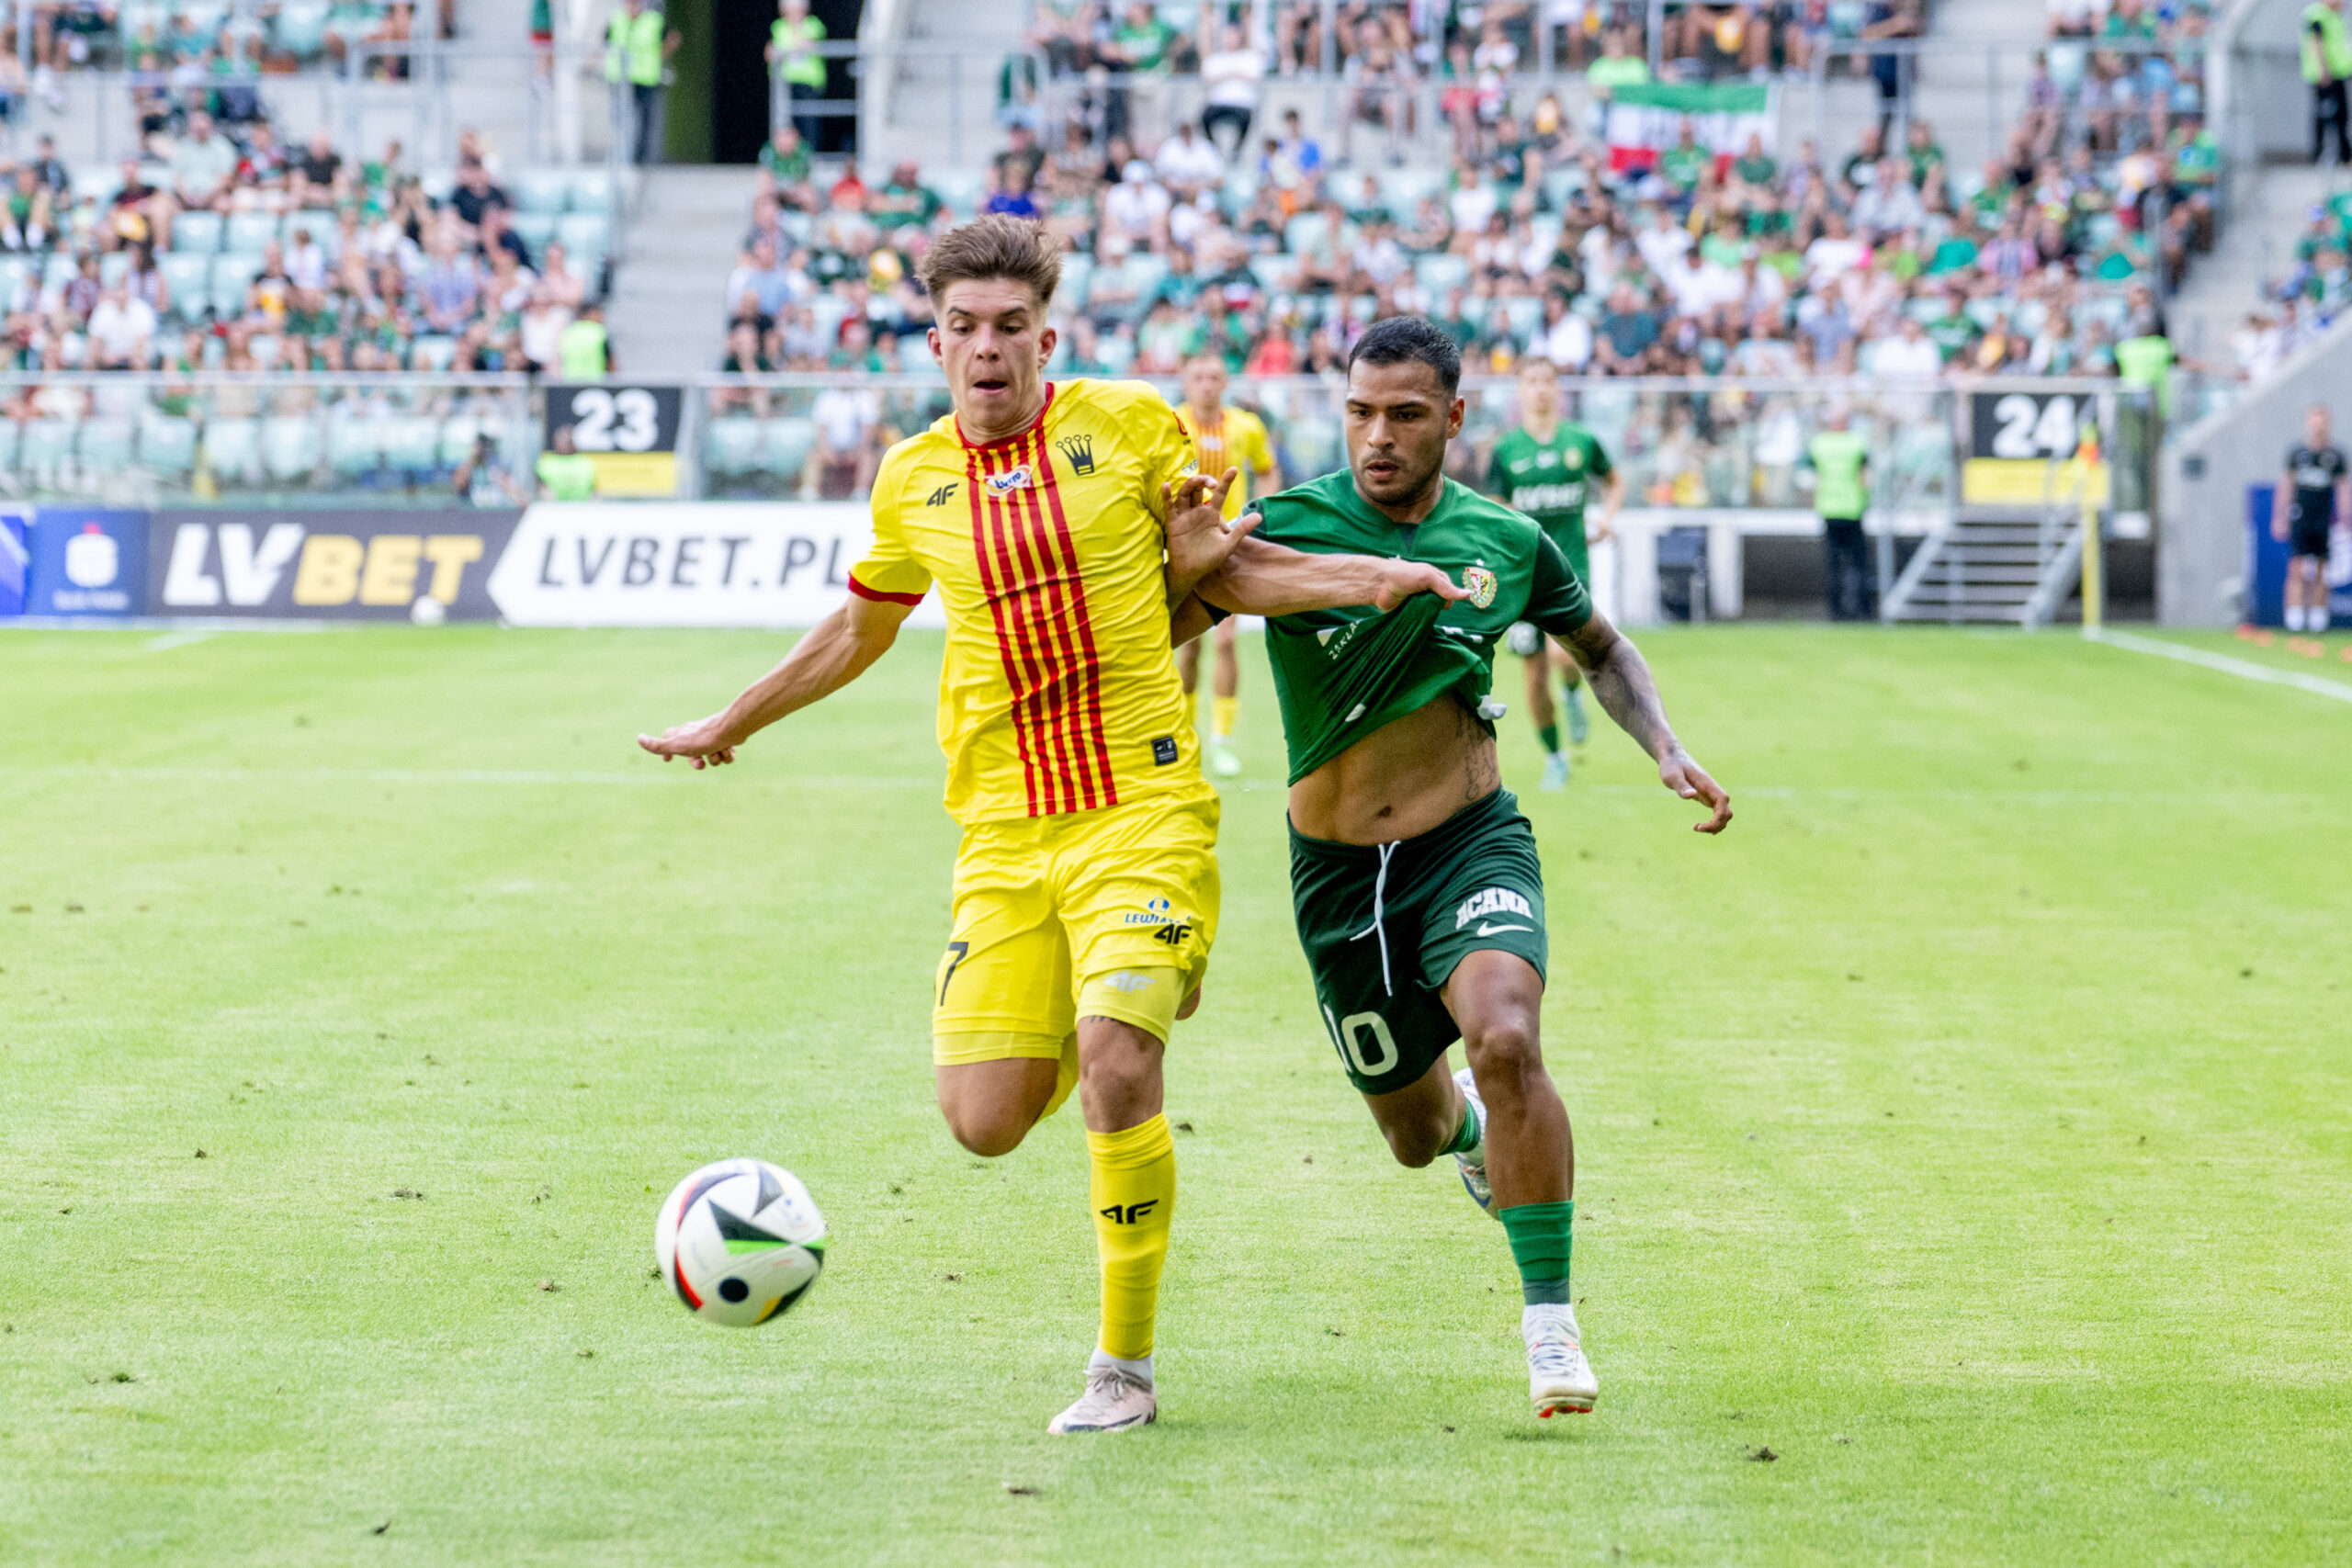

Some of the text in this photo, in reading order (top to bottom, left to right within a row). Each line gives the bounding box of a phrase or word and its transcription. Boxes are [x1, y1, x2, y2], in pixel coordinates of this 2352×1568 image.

[571, 388, 659, 450] 23
[1993, 394, 2076, 457] 24
[926, 483, 958, 506] 4F
[537, 536, 850, 588] LVBET.PL
[1456, 888, 1533, 931] ACANA
[1154, 923, 1193, 944] 4F
[940, 942, 969, 1007] 7
[1104, 971, 1156, 993] 4F
[1323, 1003, 1398, 1077] 10
[1100, 1199, 1159, 1224] 4F
